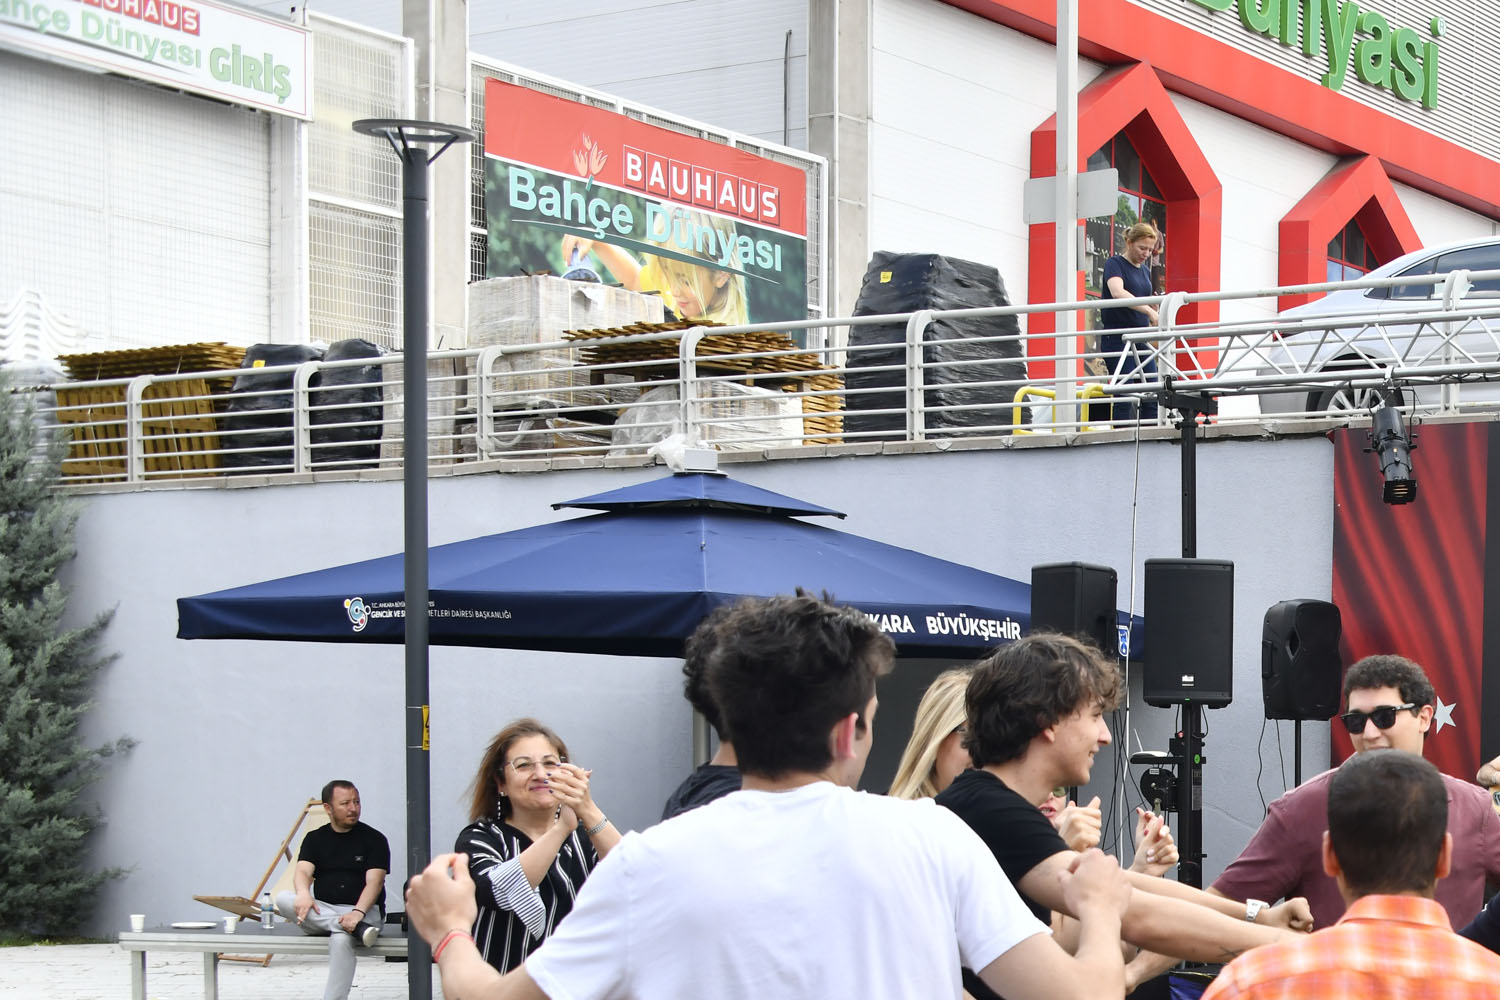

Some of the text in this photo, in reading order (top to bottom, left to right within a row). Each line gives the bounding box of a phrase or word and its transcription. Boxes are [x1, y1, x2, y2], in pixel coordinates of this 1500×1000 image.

[0, 0, 292, 104] hçe Dünyası GİRİŞ
[508, 166, 782, 272] Bahçe Dünyası
[624, 150, 779, 220] BAUHAUS
[428, 607, 451, 617] ETLERİ
[864, 612, 1022, 642] KARA BÜYÜKŞEHİR
